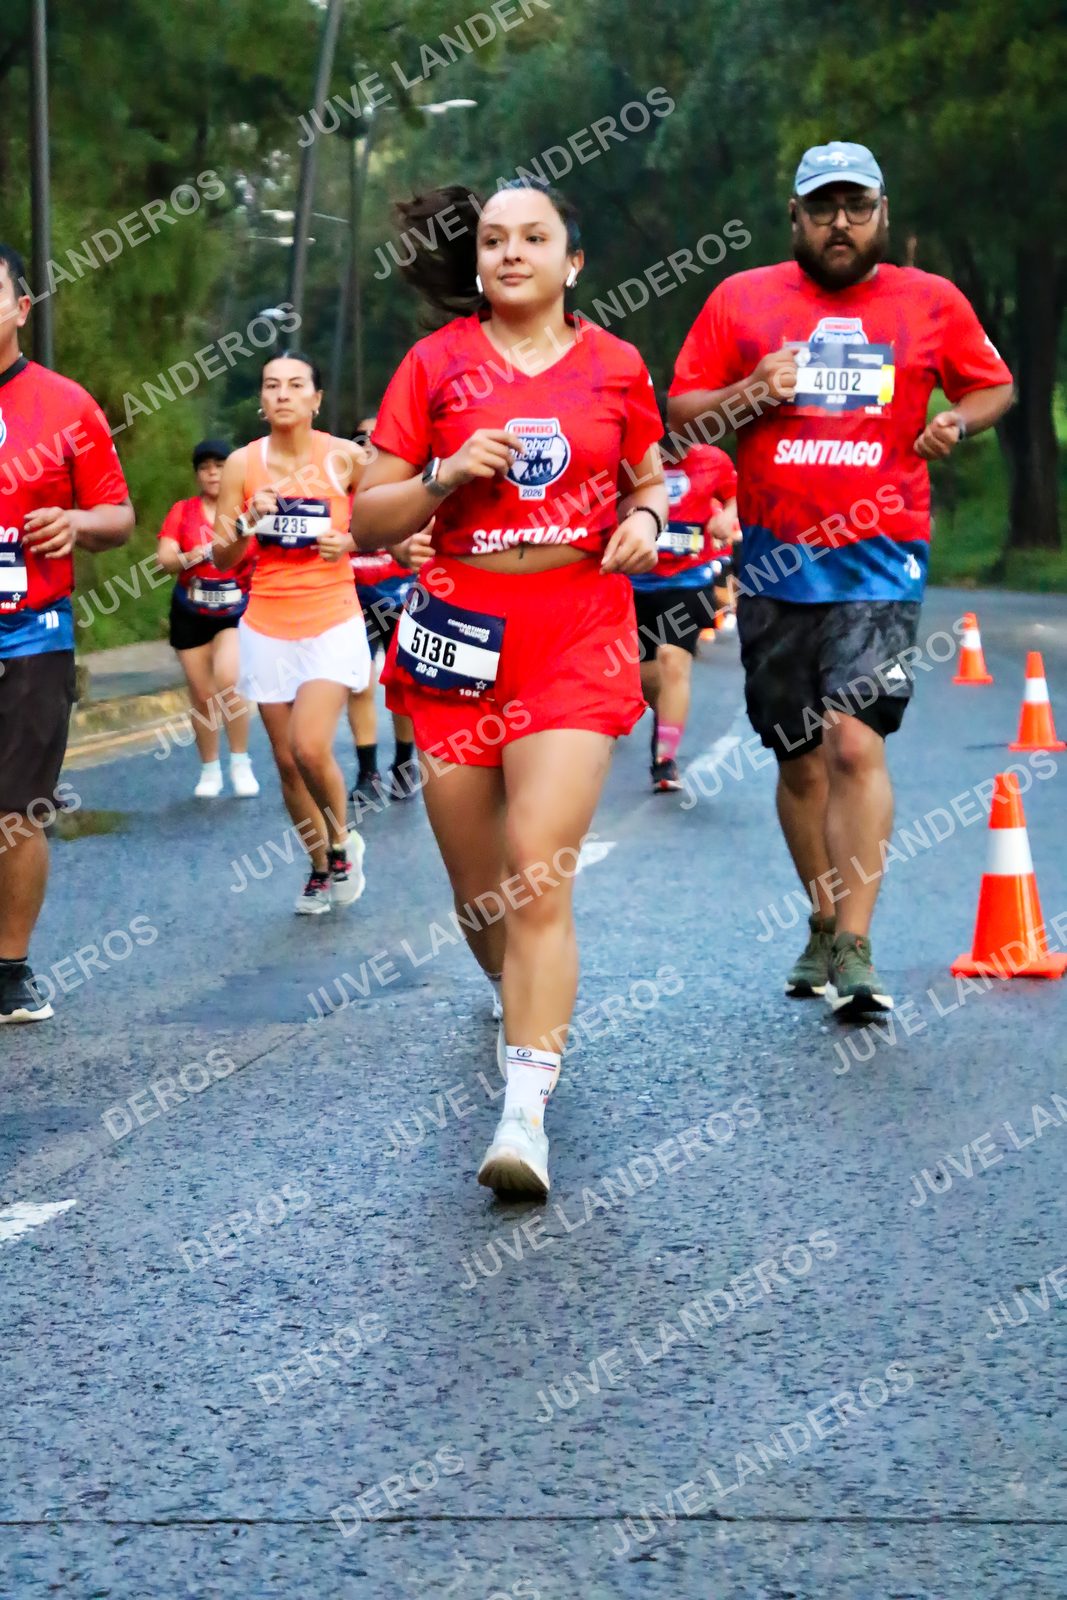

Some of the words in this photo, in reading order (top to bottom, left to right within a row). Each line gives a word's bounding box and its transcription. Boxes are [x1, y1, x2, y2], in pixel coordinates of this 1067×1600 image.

[813, 371, 862, 392] 4002
[774, 438, 883, 467] SANTIAGO
[522, 488, 543, 497] 2026
[272, 516, 308, 534] 4235
[410, 626, 457, 668] 5136
[459, 688, 480, 698] 10K
